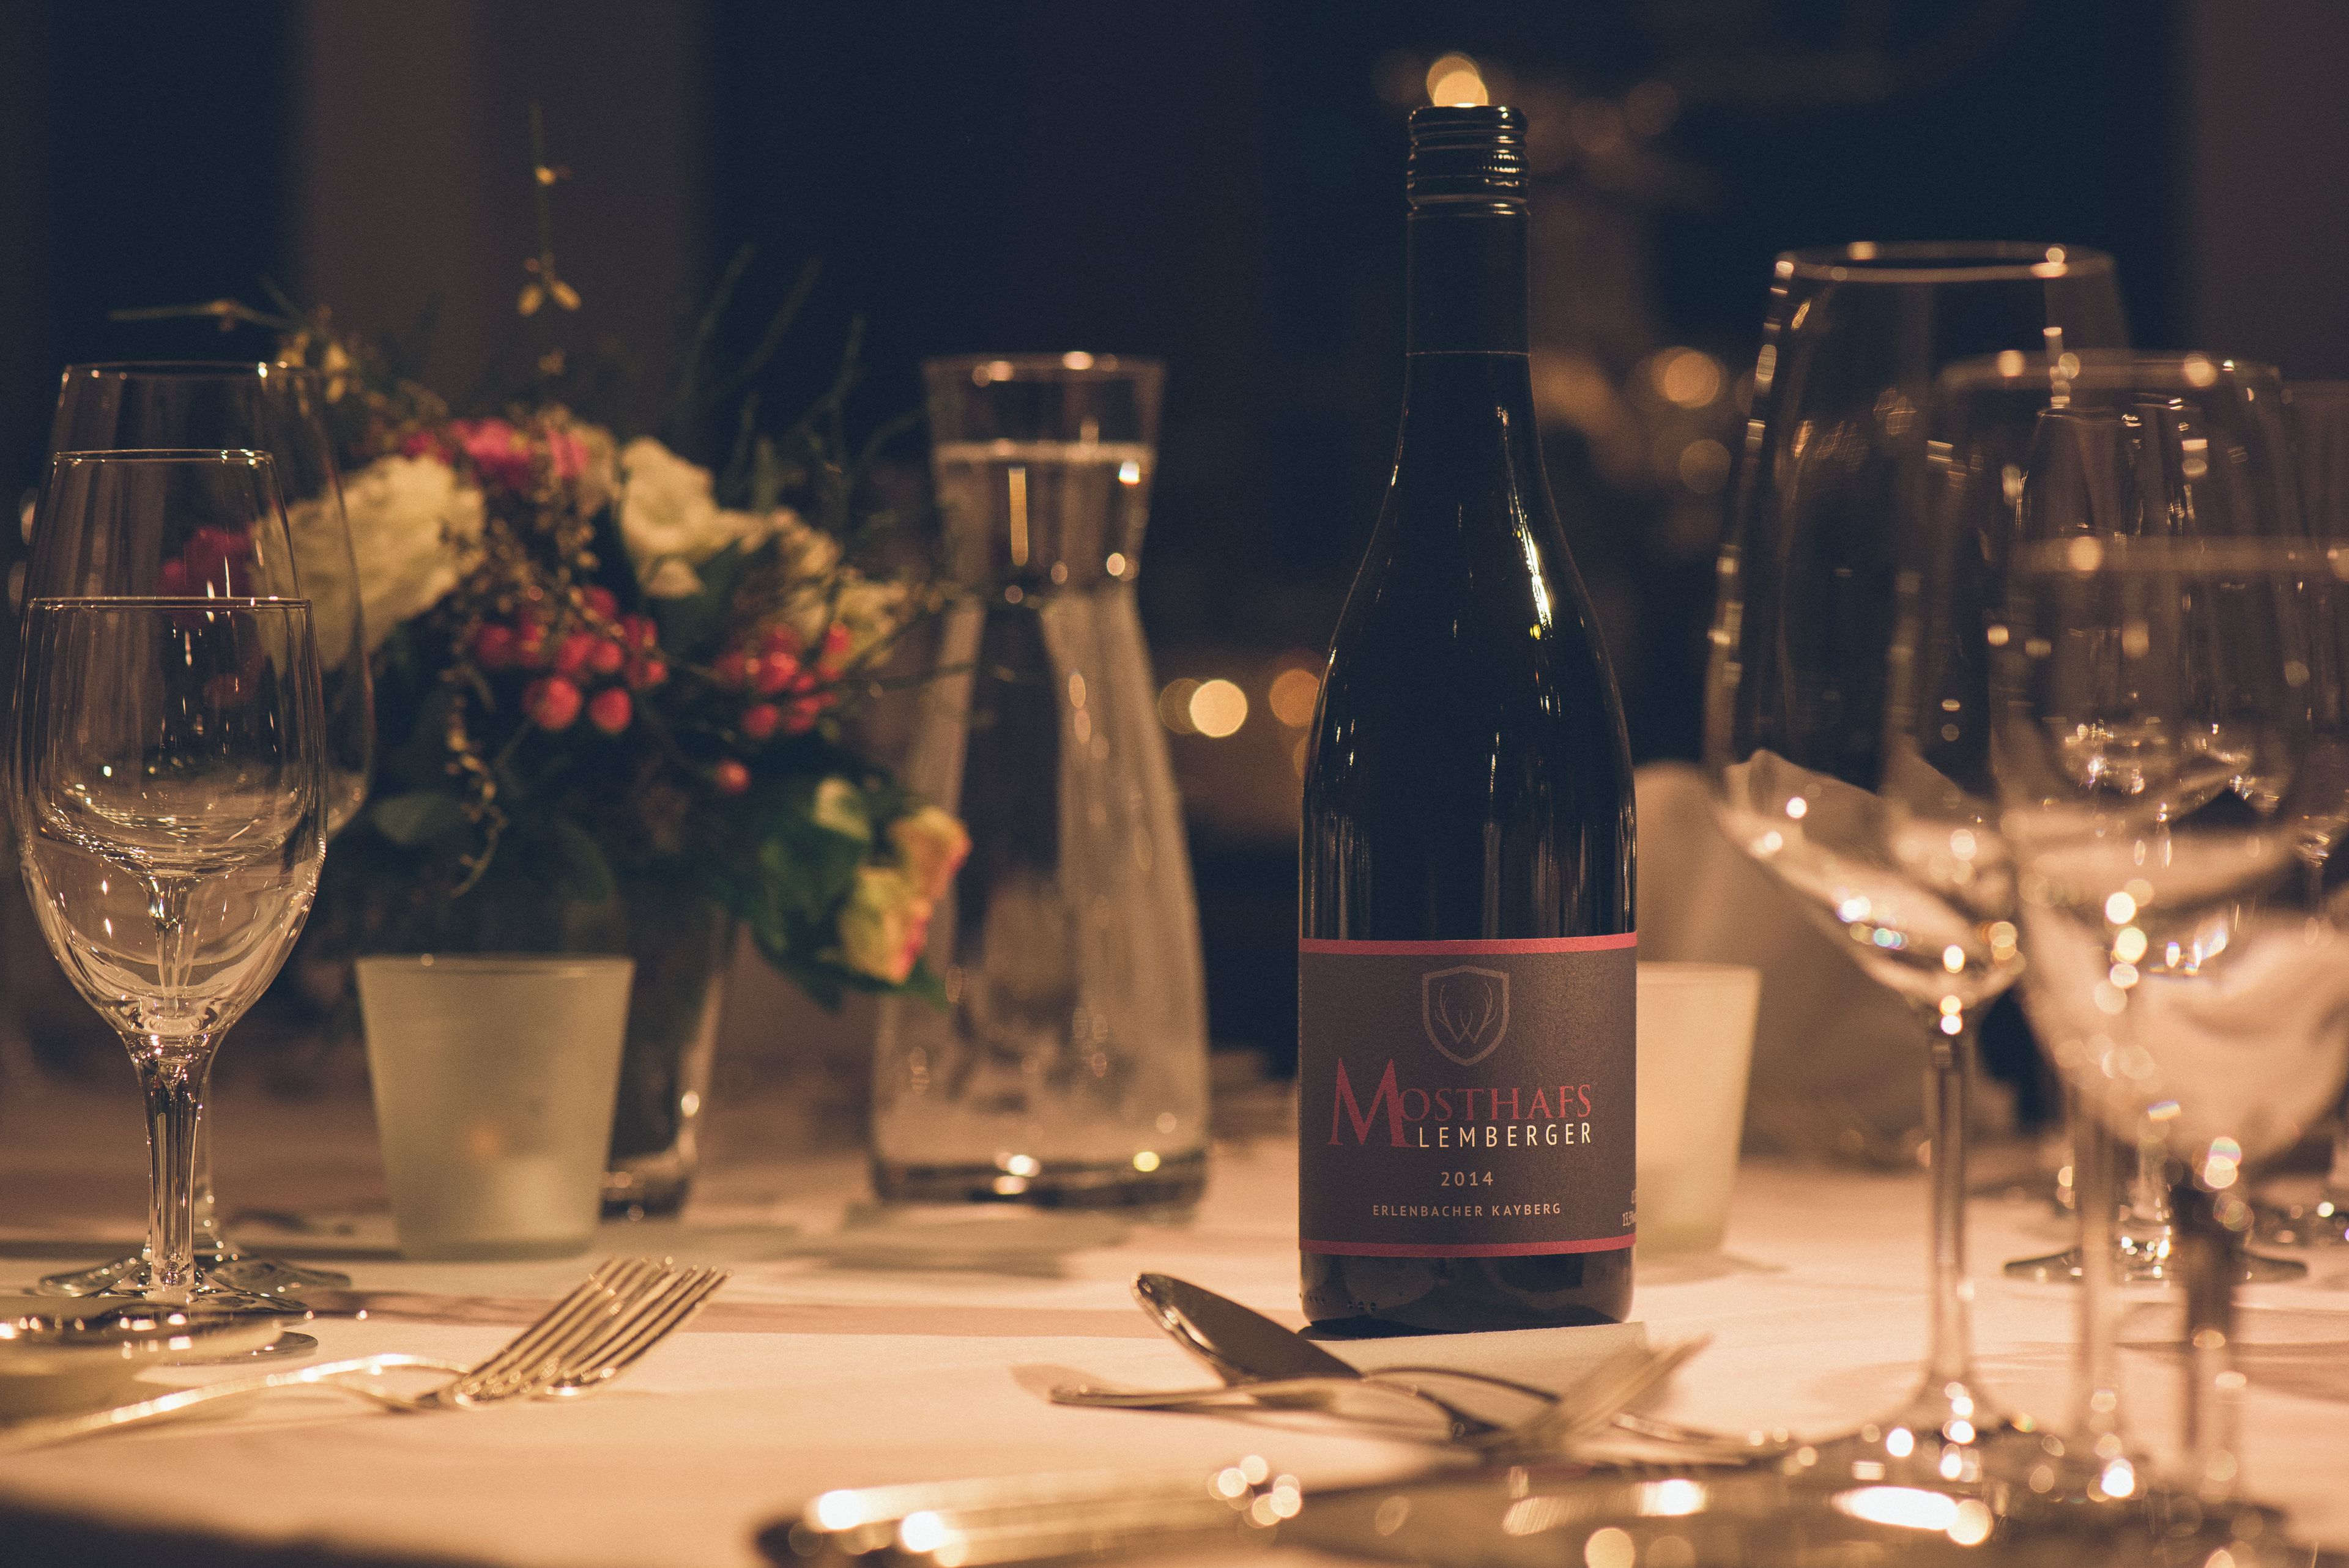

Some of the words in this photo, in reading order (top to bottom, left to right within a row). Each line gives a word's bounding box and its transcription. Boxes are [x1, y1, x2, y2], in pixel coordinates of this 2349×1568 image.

[1327, 1057, 1591, 1148] MOSTHAFS
[1419, 1122, 1591, 1148] LEMBERGER
[1441, 1171, 1493, 1186] 2014
[1373, 1205, 1482, 1217] ERLENBACHER
[1492, 1203, 1560, 1216] KAYBERG
